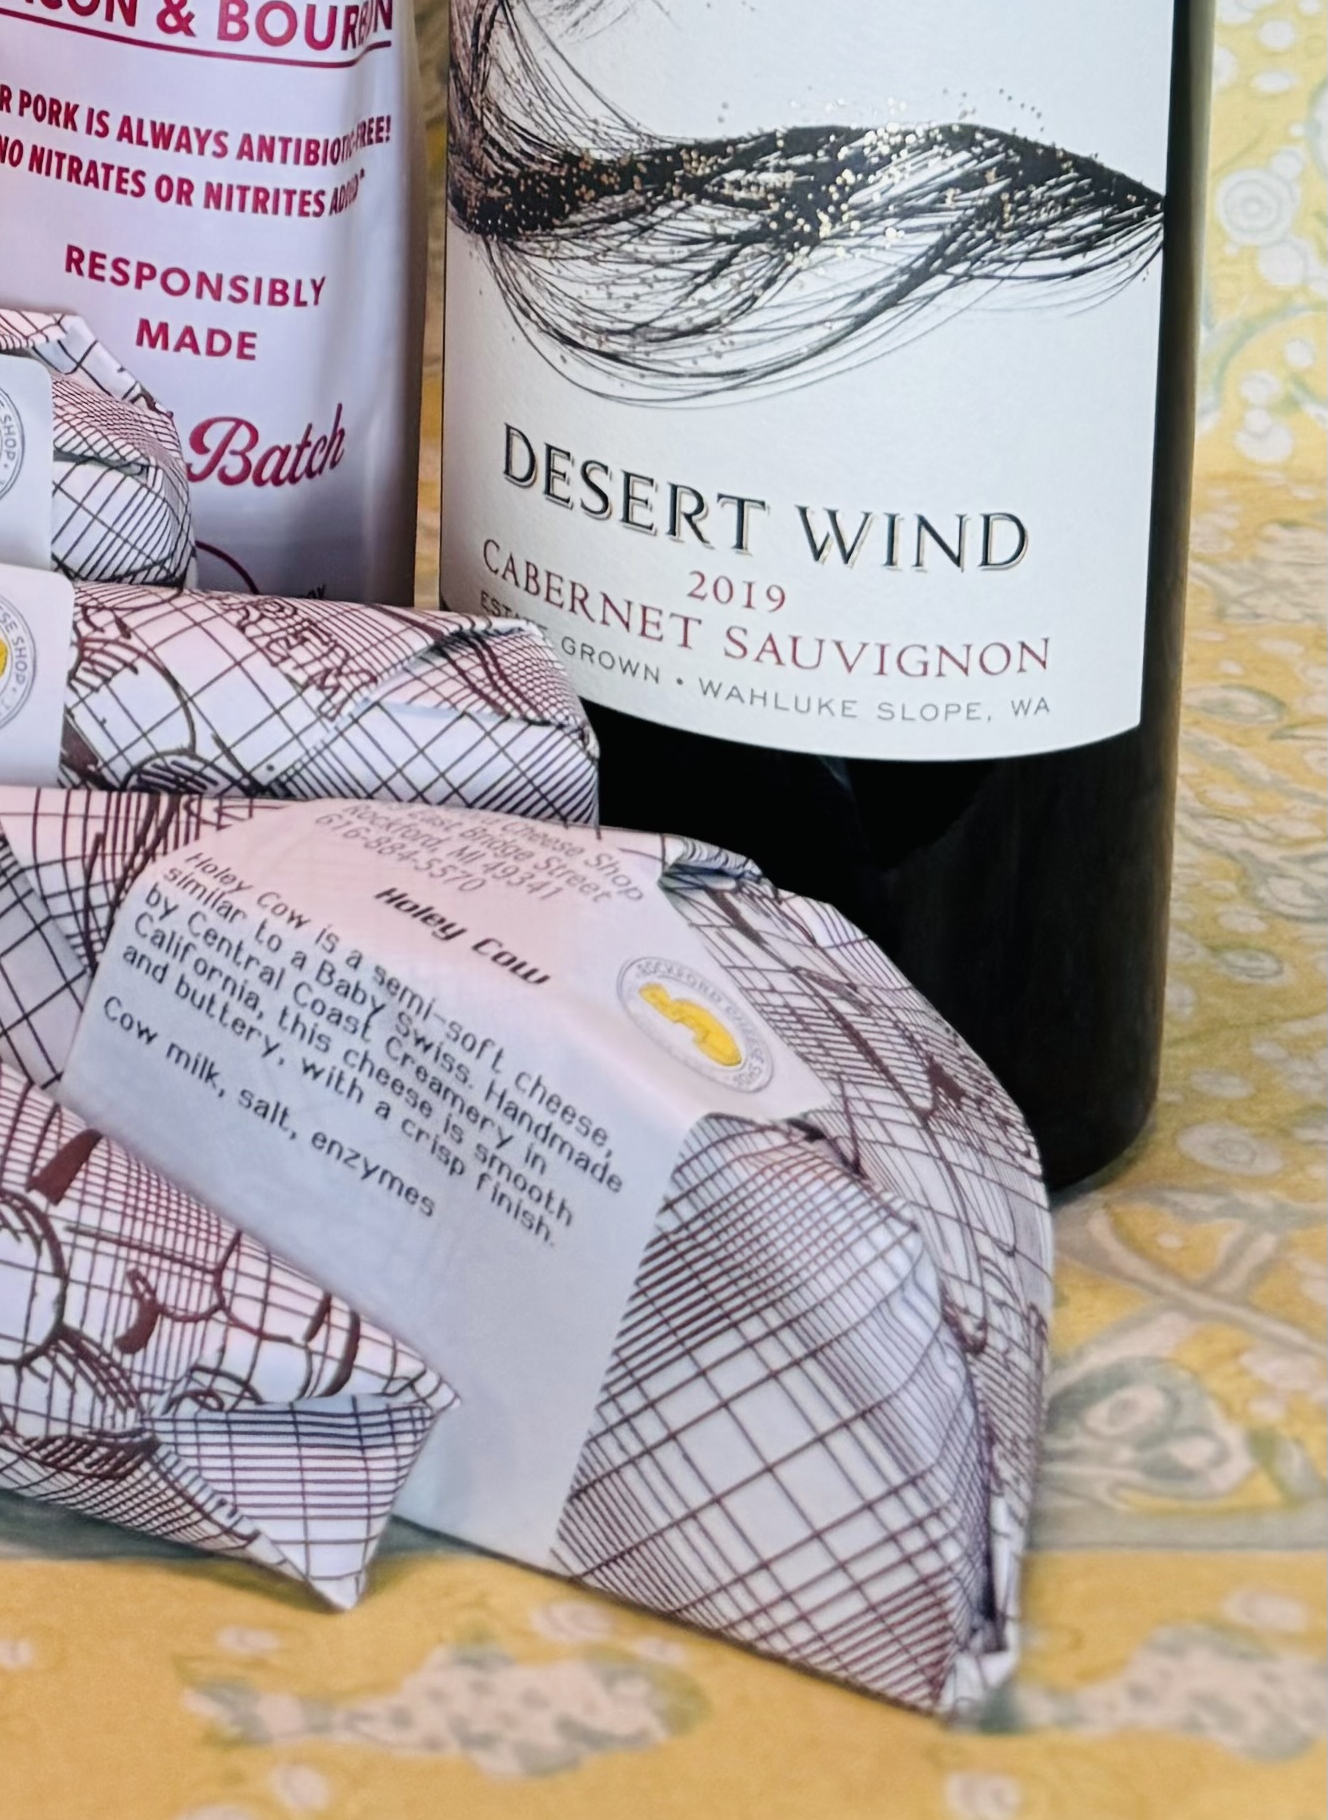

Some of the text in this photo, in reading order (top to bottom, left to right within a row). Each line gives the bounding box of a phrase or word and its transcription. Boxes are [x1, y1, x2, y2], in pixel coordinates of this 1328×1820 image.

[18, 89, 80, 132] PORK
[85, 106, 110, 139] IS
[116, 115, 228, 159] ALWAYS
[28, 144, 146, 198] NITRATES
[155, 174, 193, 206] OR
[204, 181, 326, 218] NITRITES
[65, 244, 326, 308] RESPONSIBLY
[135, 317, 257, 361] MADE
[0, 414, 17, 462] SHOP
[186, 403, 345, 487] Batch
[503, 422, 1030, 572] DESERT WIND
[483, 538, 1051, 679] CABERNET SAUVIGNON
[687, 569, 787, 613] 2019
[561, 636, 1051, 723] GROWN WAHLUKE SLOPE, WA
[374, 887, 551, 986] Holey Cow
[145, 881, 548, 1176] by Central Coast Creamery in
[103, 995, 436, 1217] Cow milk, salt, enzymes
[123, 945, 556, 1248] and buttery, with a crisp finish.
